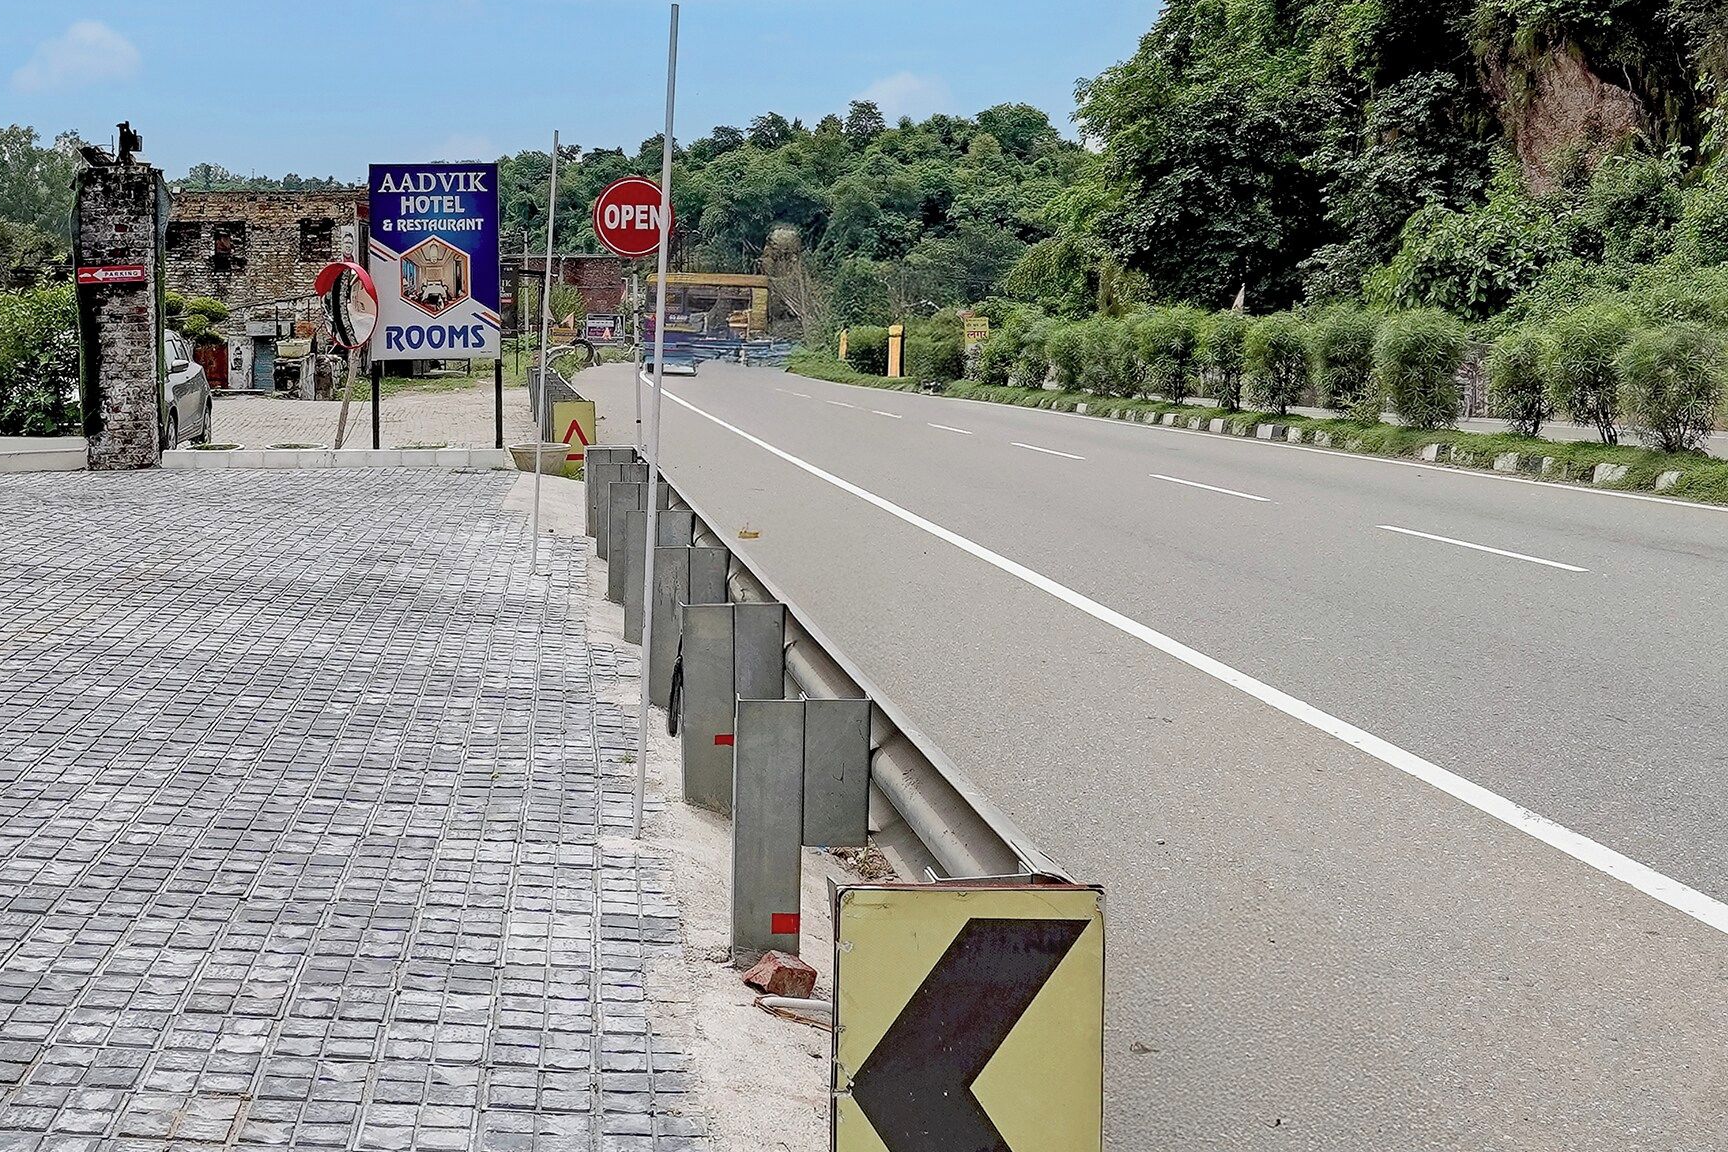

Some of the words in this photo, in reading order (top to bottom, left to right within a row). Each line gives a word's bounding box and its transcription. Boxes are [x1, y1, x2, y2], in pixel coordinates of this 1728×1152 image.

[377, 172, 488, 193] AADVIK
[400, 195, 465, 215] HOTEL
[382, 219, 393, 231] &
[397, 218, 484, 232] RESTAURANT
[604, 204, 668, 230] OPEN
[386, 325, 485, 352] ROOMS
